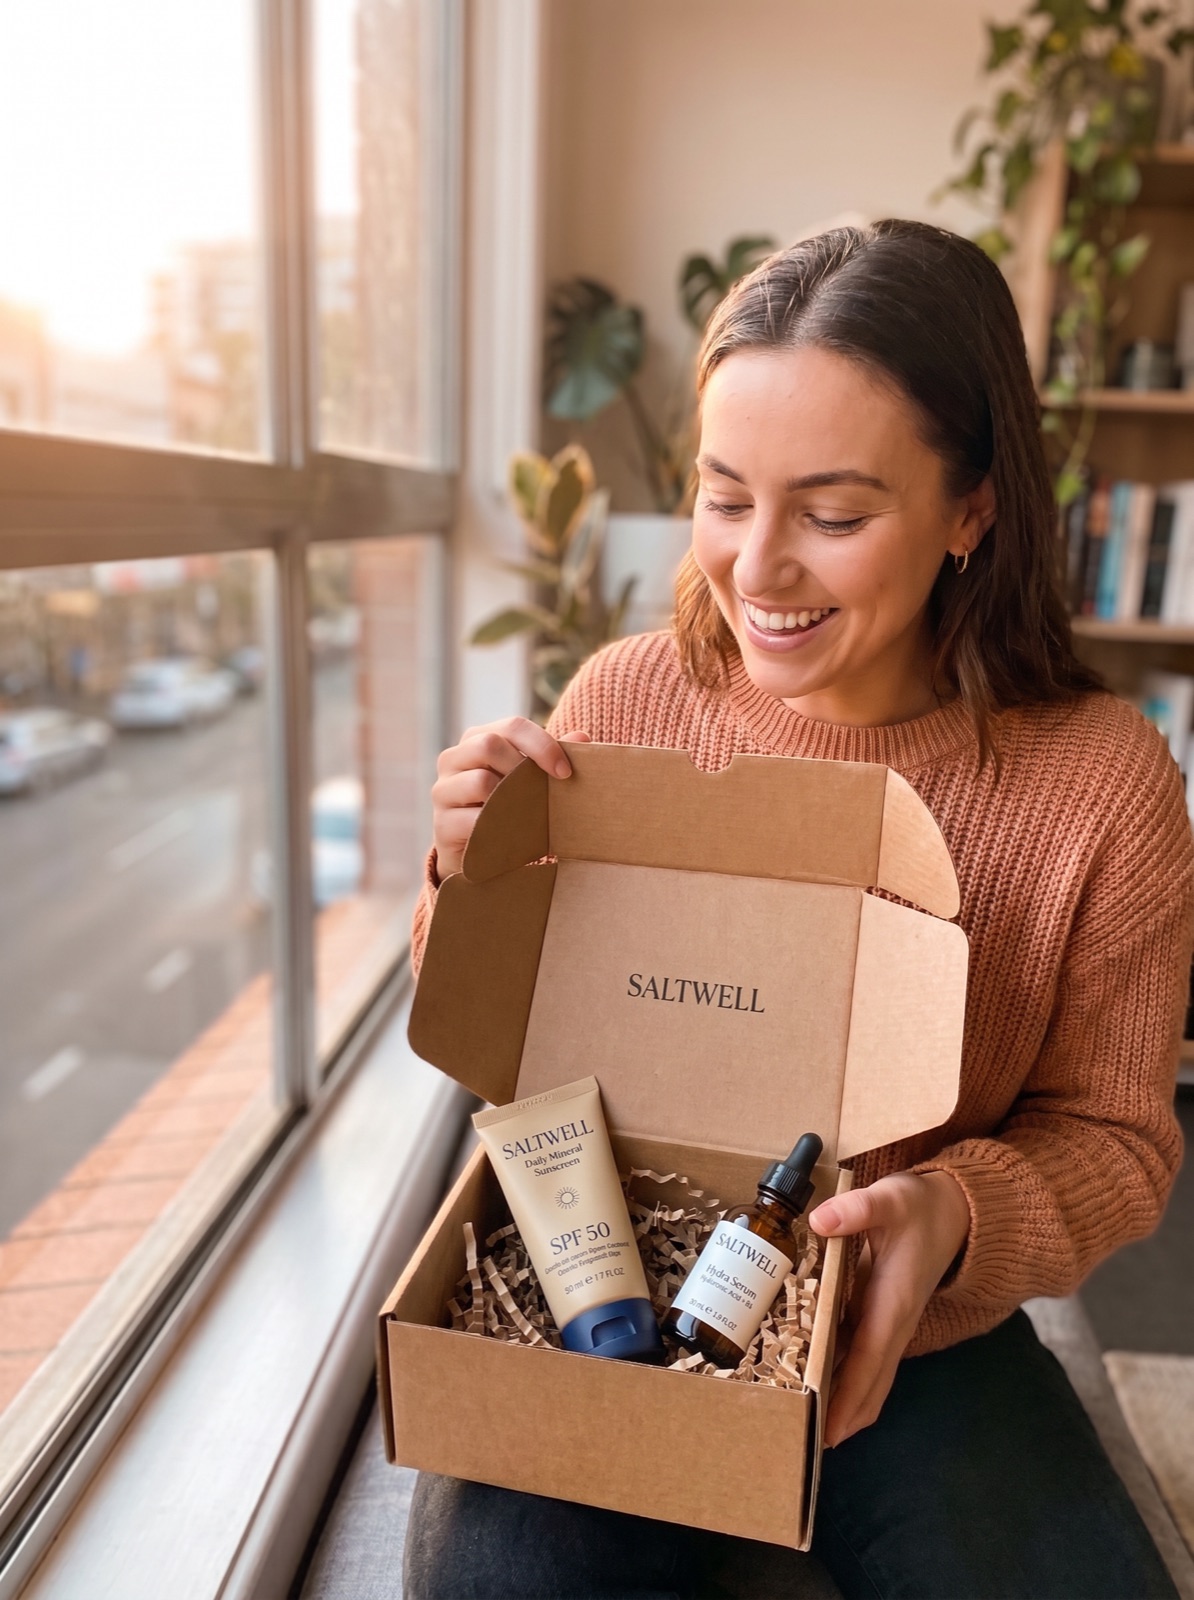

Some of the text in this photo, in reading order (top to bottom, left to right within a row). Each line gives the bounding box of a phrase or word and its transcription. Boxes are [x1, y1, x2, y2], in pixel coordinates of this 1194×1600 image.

[627, 973, 765, 1013] SALTWELL
[502, 1119, 594, 1160] SALTWELL
[524, 1143, 583, 1169] Daily Mineral
[534, 1158, 580, 1177] Sunscreen
[550, 1221, 611, 1255] SPF 50
[715, 1232, 778, 1279] SALTWELL
[706, 1263, 757, 1300] Hydra Serum
